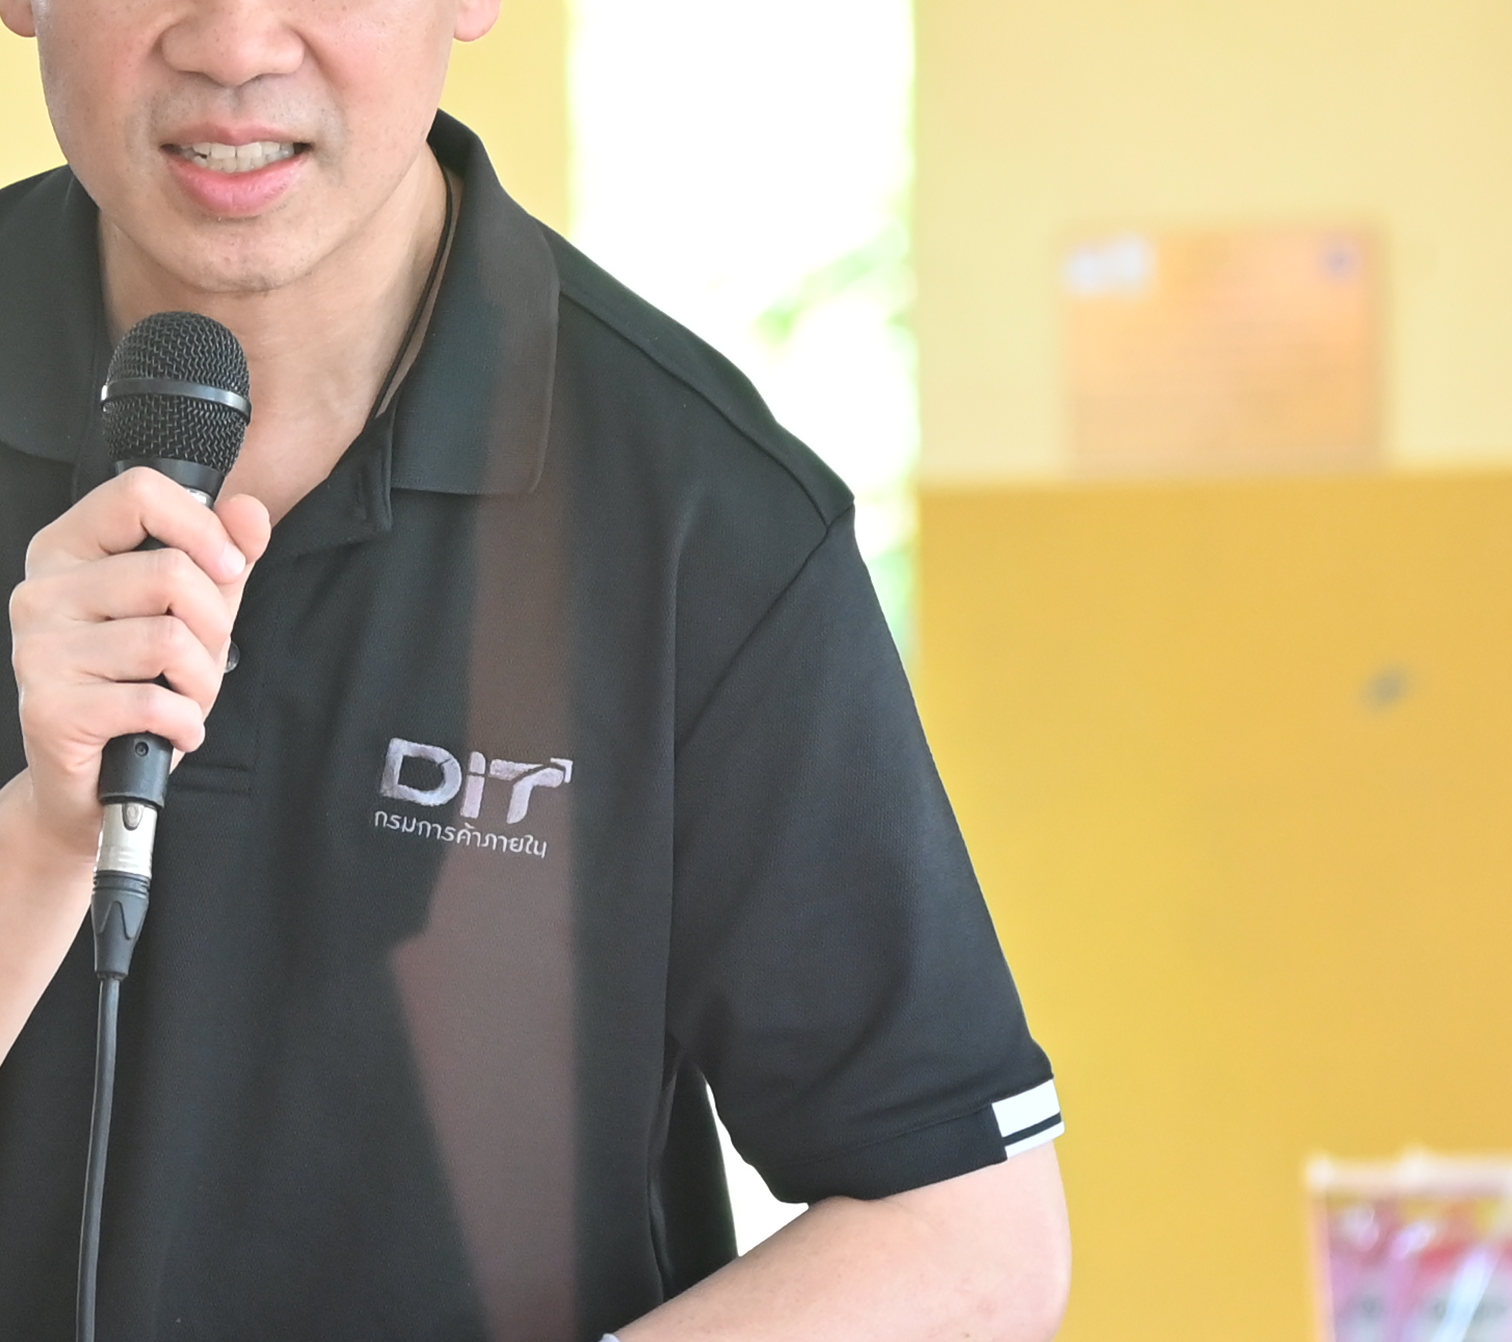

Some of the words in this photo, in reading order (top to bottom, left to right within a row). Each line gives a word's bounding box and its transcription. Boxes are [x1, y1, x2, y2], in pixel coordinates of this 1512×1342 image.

[374, 810, 547, 859] กรมการค้าภายใน
